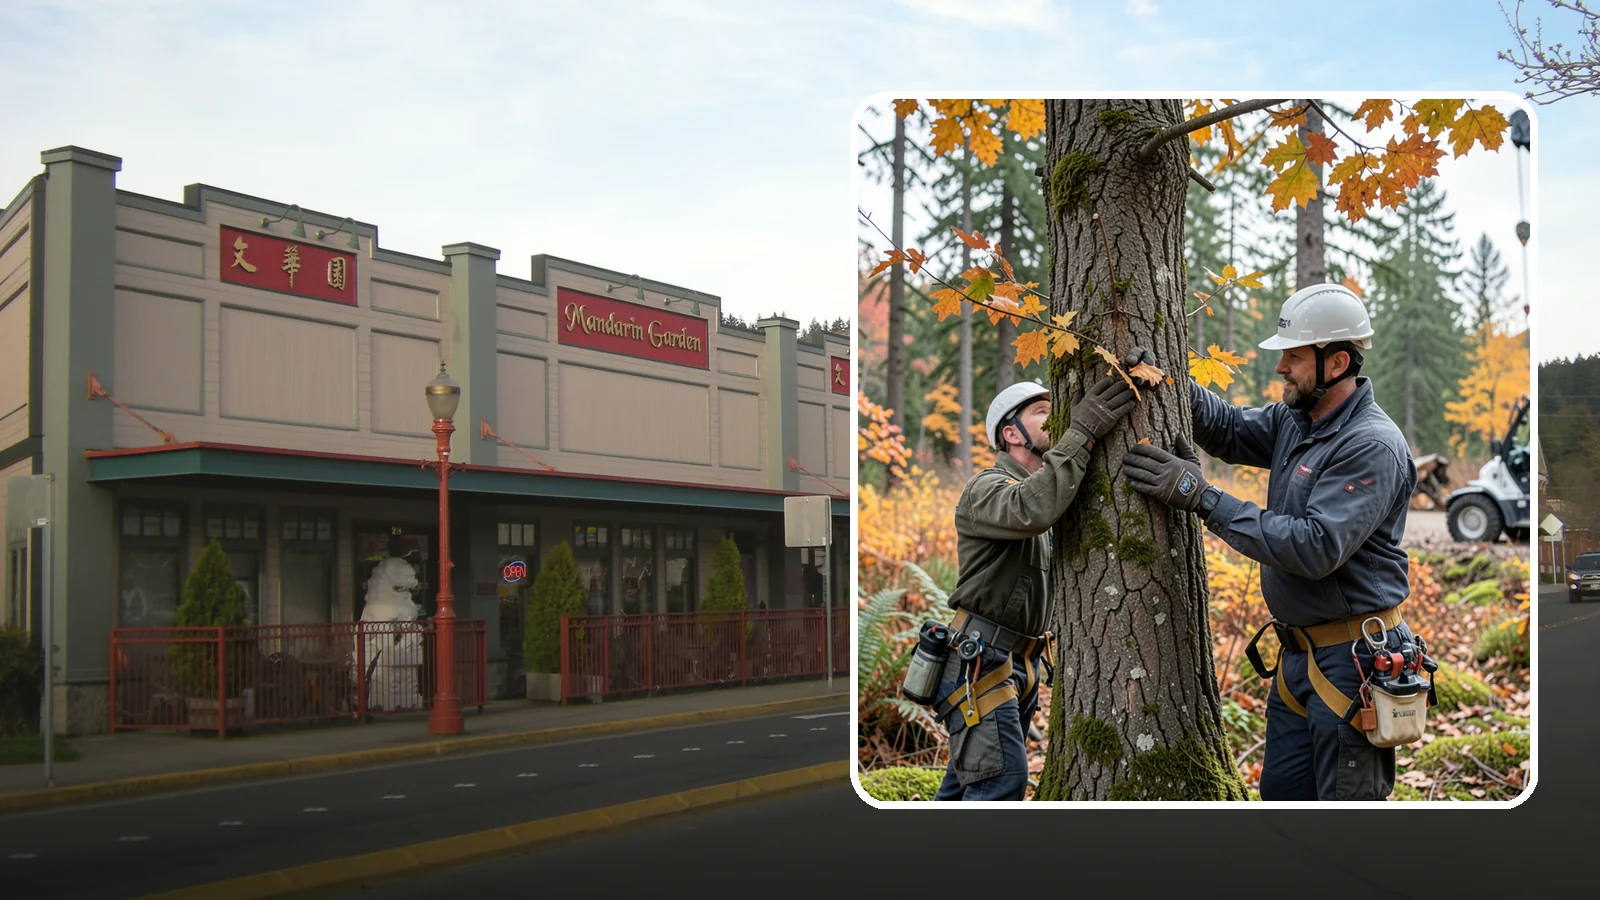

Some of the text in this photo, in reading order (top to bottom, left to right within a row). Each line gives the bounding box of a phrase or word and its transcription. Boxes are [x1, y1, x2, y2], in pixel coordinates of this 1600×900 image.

[564, 302, 701, 352] Mandarin Garden
[503, 565, 527, 578] OPEN
